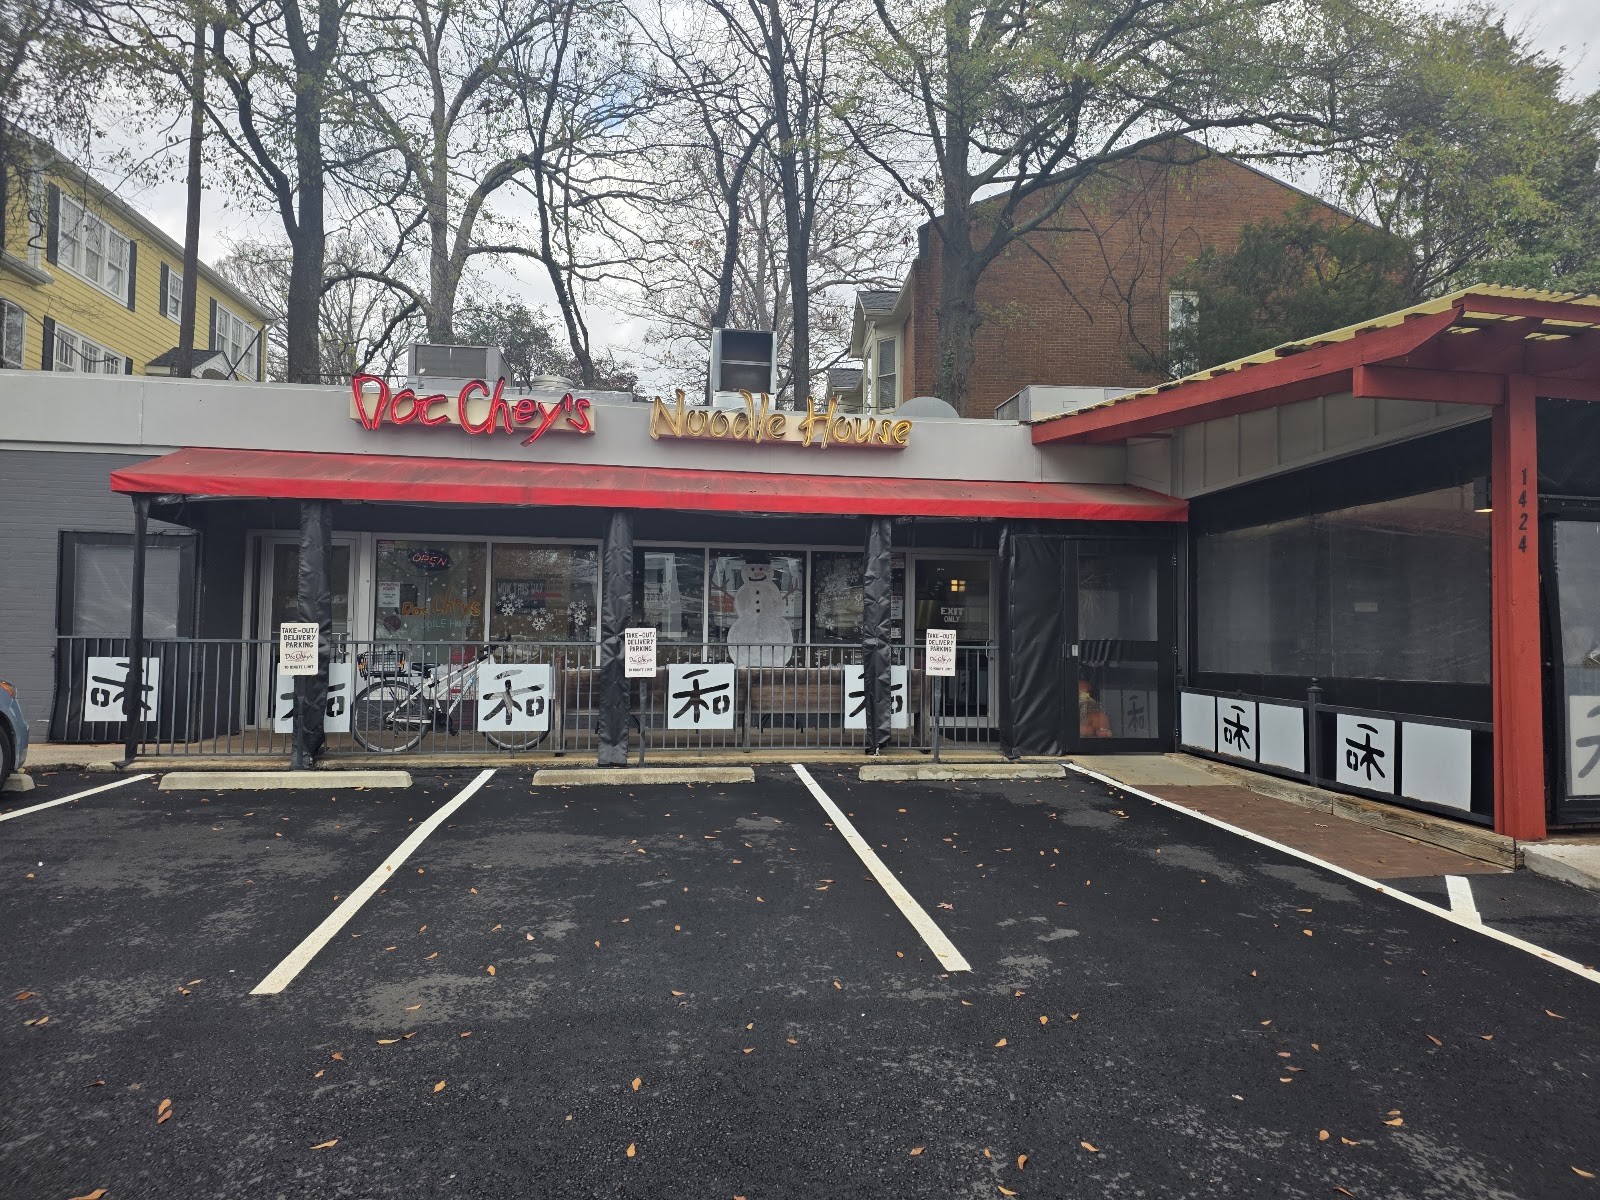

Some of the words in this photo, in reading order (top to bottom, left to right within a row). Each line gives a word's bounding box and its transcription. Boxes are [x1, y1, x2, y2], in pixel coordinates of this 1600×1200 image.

[352, 373, 449, 430] Doc
[458, 376, 591, 447] Chey's
[649, 388, 787, 443] Noodle
[798, 395, 914, 449] House
[1518, 467, 1529, 553] 1424
[412, 553, 448, 567] OPEN
[512, 582, 530, 596] THIS
[940, 607, 965, 616] EXIT
[672, 669, 731, 723] 和
